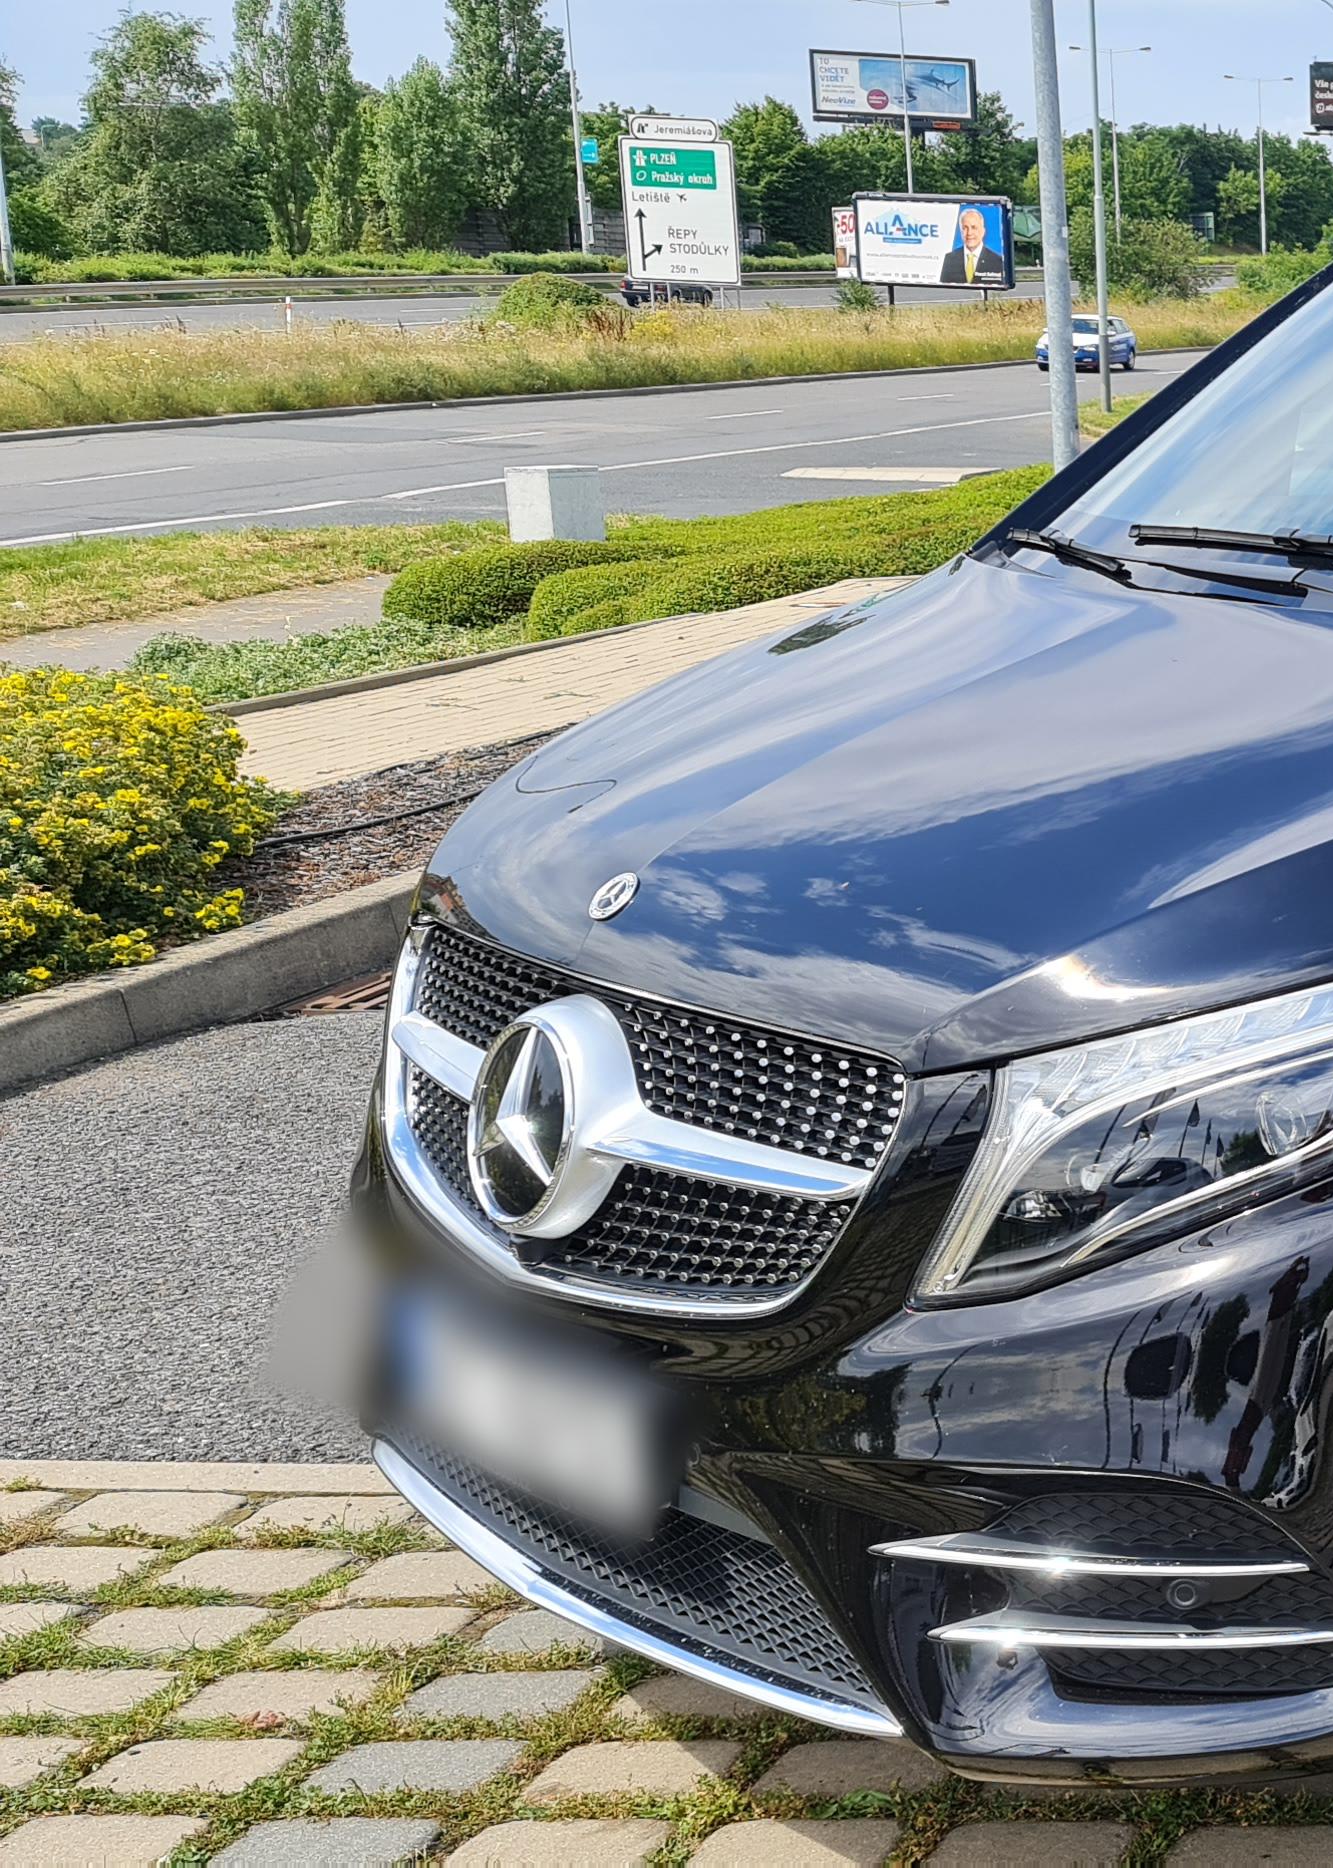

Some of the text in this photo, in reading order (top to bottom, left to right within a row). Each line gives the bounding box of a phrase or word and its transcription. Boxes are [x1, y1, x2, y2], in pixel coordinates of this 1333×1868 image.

[653, 124, 713, 137] Jeremiášova
[650, 152, 677, 165] PLZEŇ
[651, 171, 713, 185] Pražský okruh
[631, 191, 671, 204] Letiště
[667, 226, 698, 239] ŘEPY
[669, 242, 730, 256] STODŮLKY
[670, 264, 686, 274] 250
